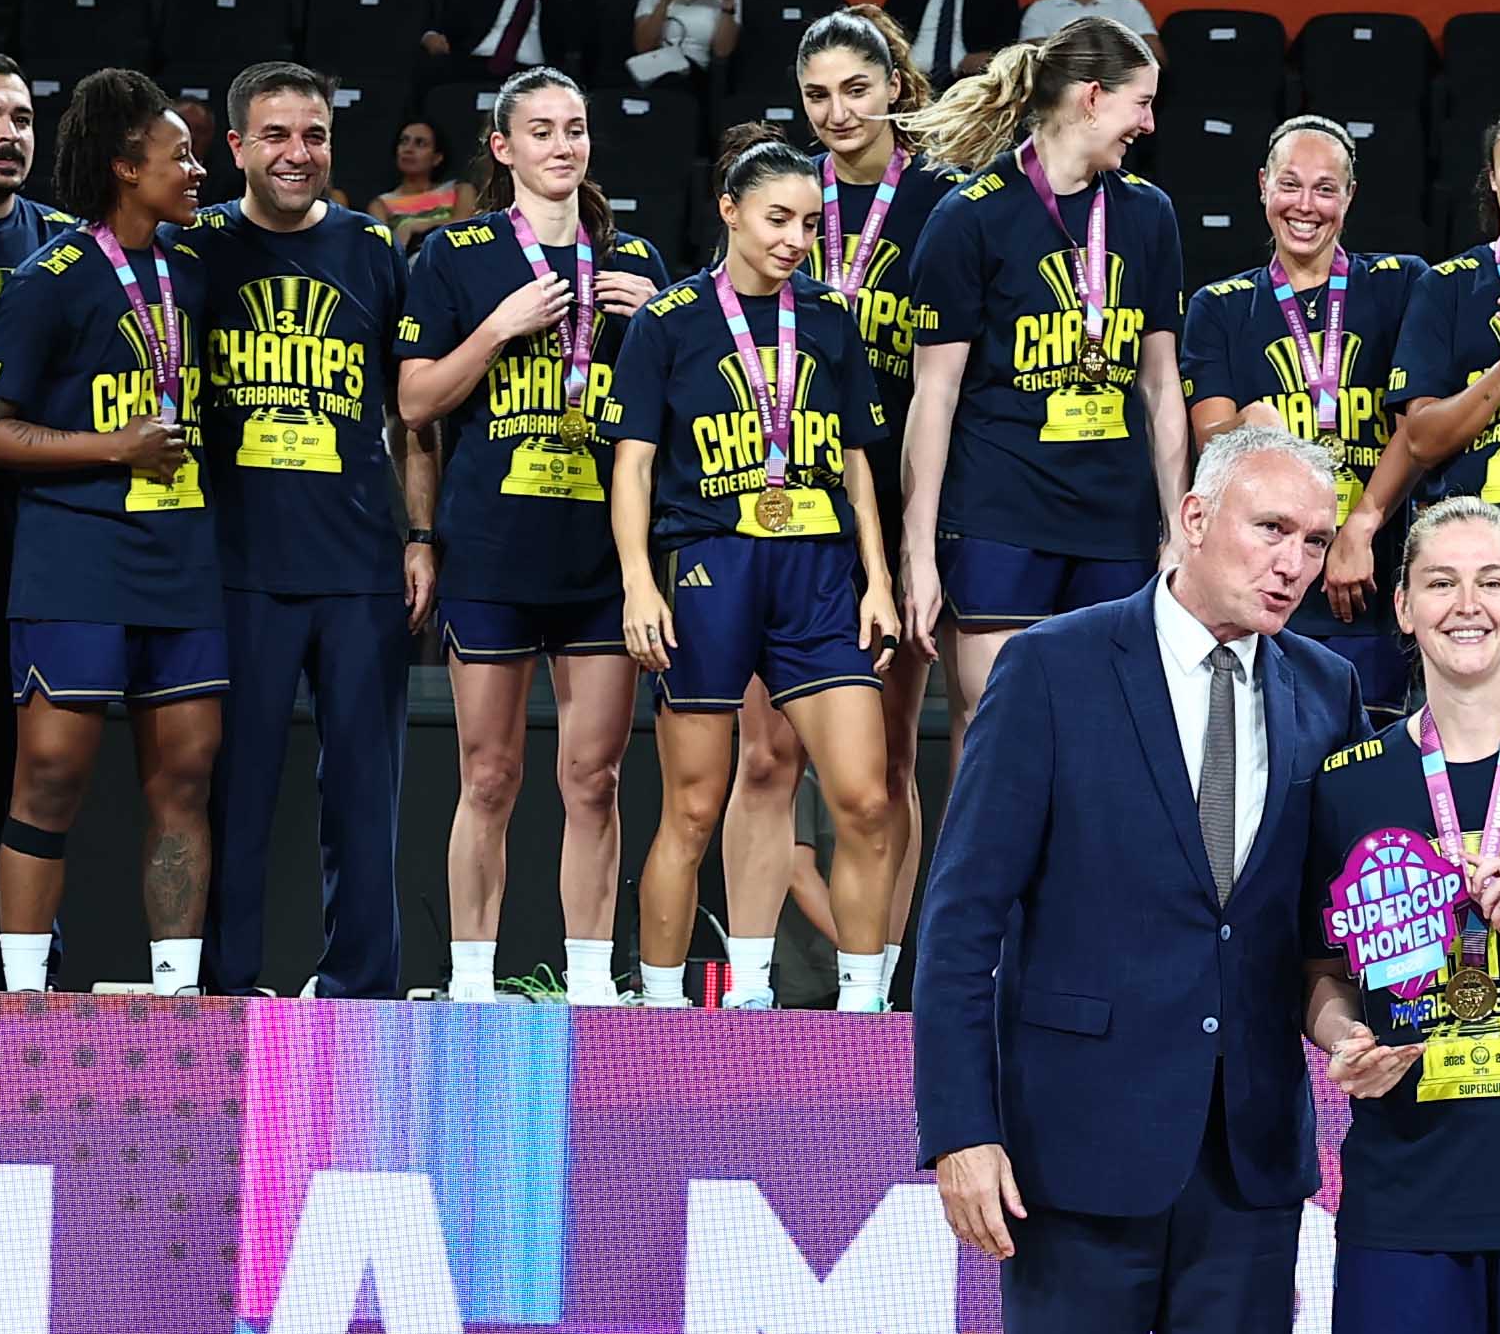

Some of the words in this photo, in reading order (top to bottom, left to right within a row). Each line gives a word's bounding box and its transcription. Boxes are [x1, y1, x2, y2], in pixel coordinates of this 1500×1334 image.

[446, 225, 496, 248] tarfin
[646, 285, 699, 318] tarfin
[276, 310, 305, 335] 3x
[208, 329, 365, 400] CHAMPS
[1330, 871, 1462, 939] SUPERCUP
[1356, 912, 1448, 965] WOMEN
[1443, 1055, 1466, 1068] 2026
